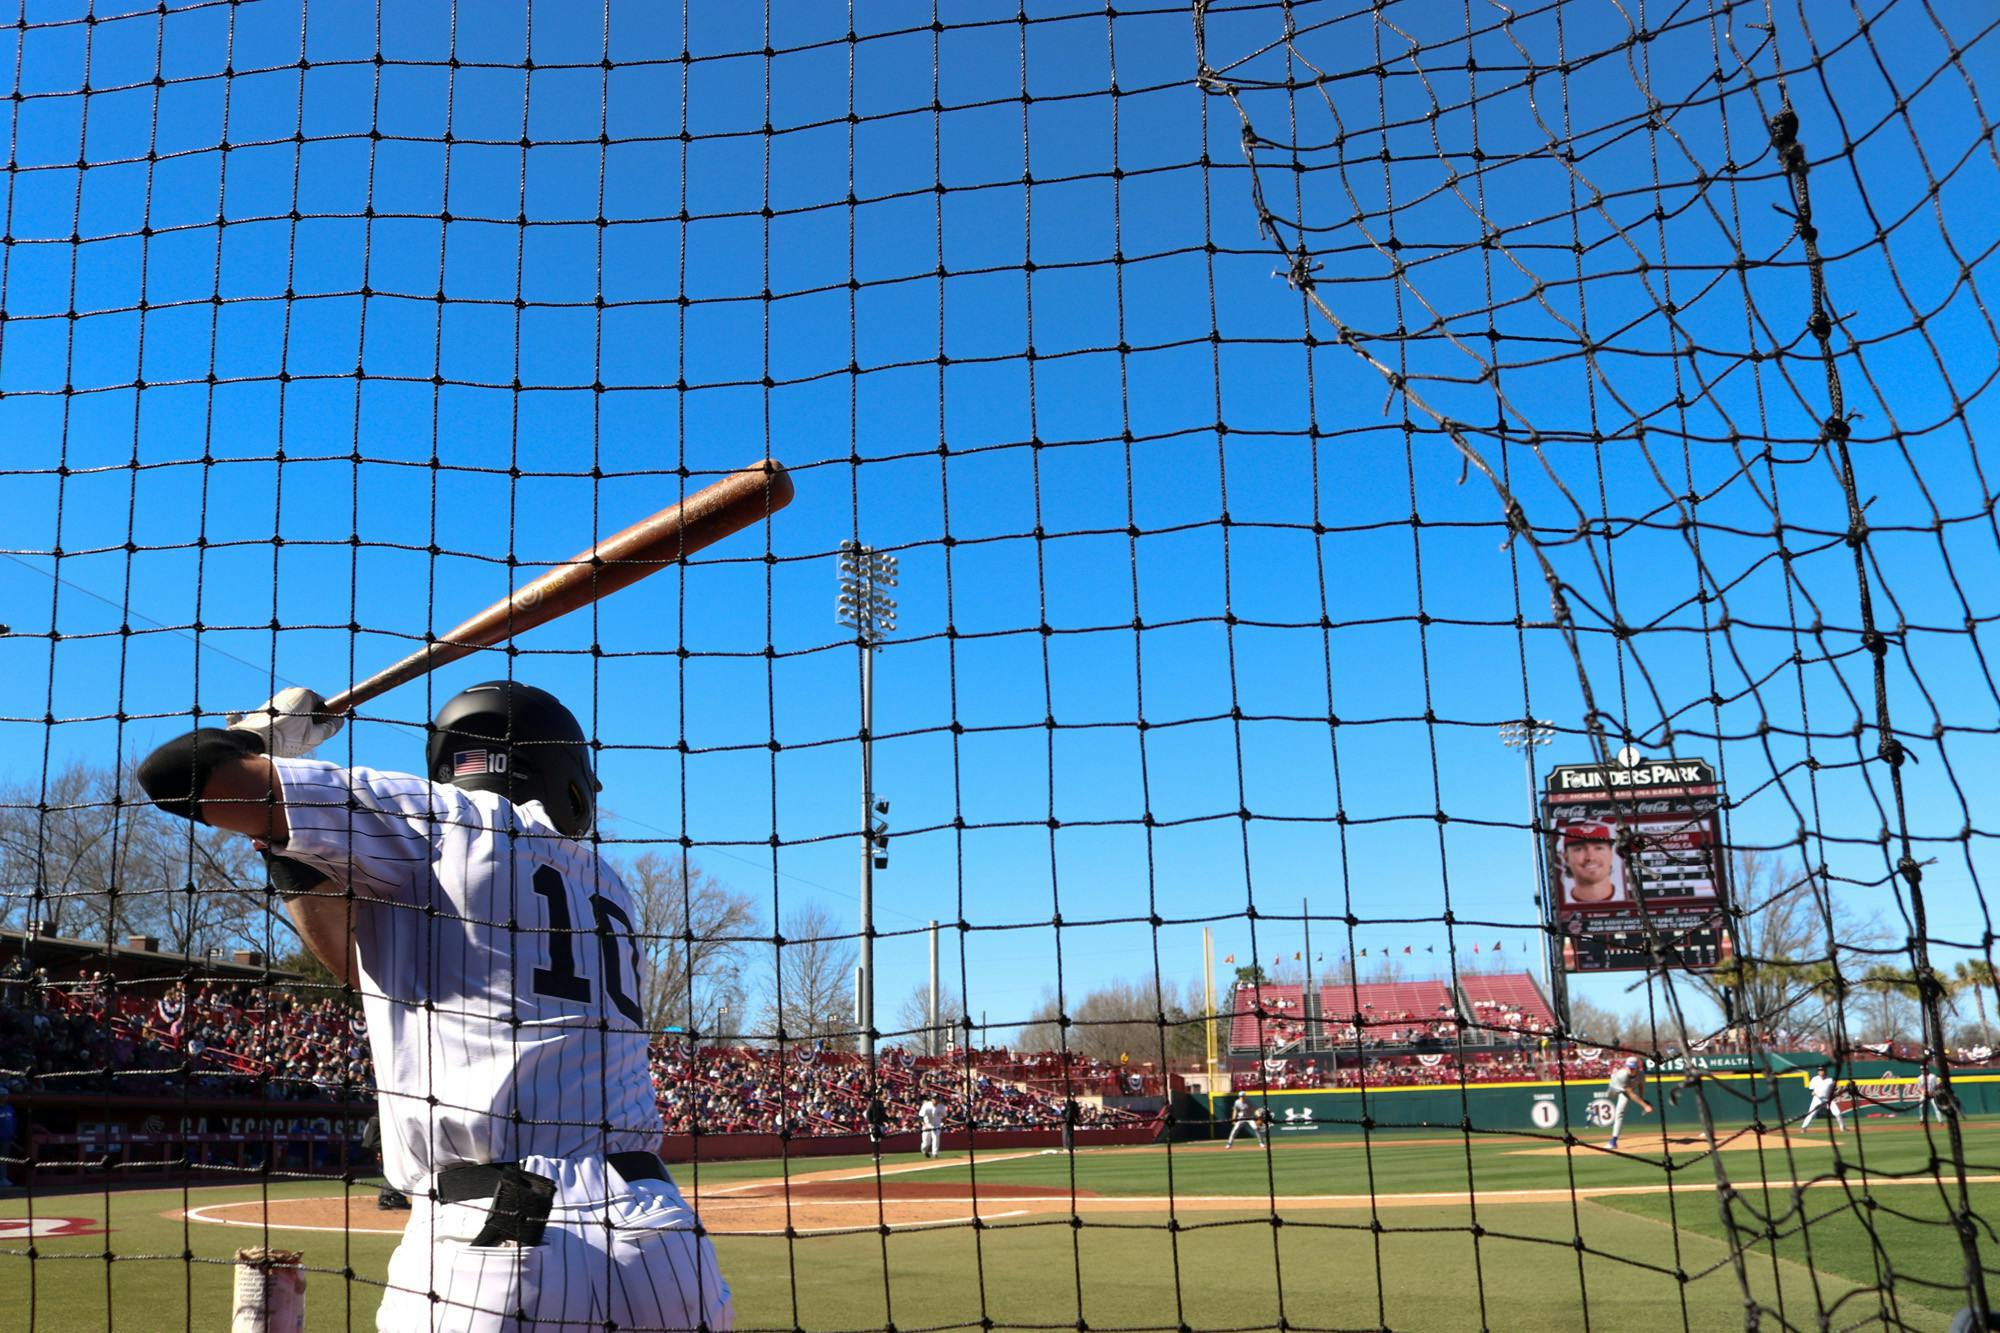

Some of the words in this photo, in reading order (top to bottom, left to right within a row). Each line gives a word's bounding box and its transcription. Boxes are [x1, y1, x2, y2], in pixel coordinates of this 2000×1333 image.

[488, 753, 507, 773] 10
[1653, 766, 1701, 784] PARK
[1652, 786, 1694, 795] BASEBAL
[531, 862, 645, 1030] 10
[1710, 1058, 1750, 1066] HEALTH
[1542, 1106, 1549, 1122] 1
